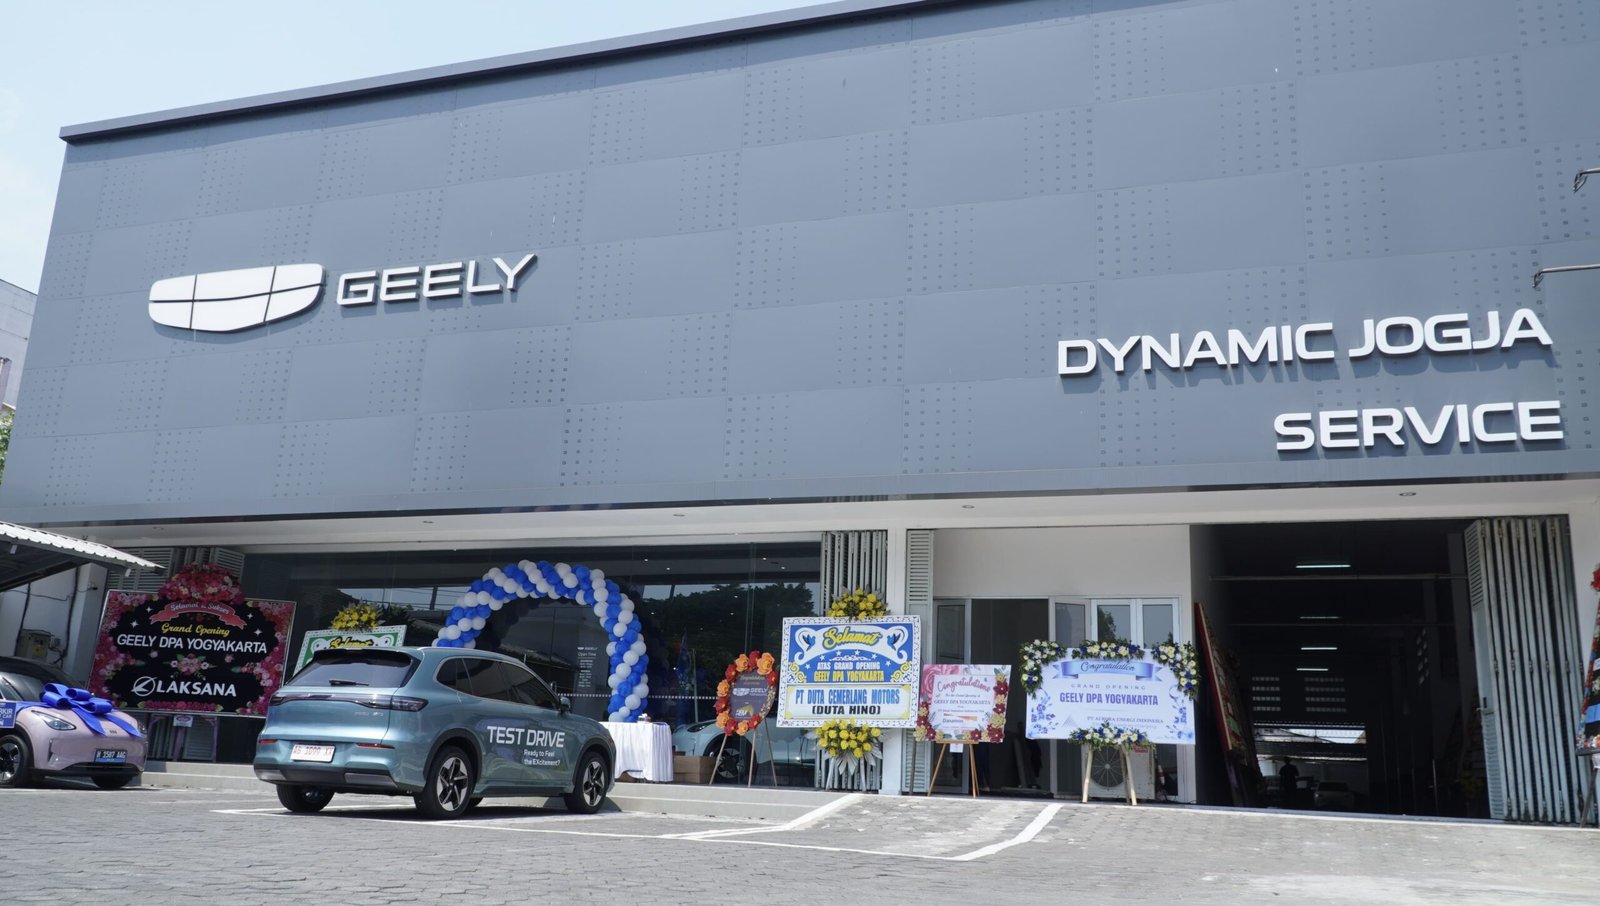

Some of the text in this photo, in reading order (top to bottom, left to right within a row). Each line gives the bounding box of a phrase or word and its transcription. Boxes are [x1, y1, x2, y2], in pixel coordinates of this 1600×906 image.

[336, 253, 536, 305] GEELY
[1058, 308, 1553, 376] DYNAMIC JOGJA
[1273, 400, 1564, 451] SERVICE
[161, 622, 230, 637] Grand Opening
[822, 625, 883, 650] Selamat
[117, 633, 267, 653] GEELY DPA YOGYAKARTA
[816, 661, 881, 670] ATAS GRAND OPENING
[813, 670, 884, 682] GEELY DPA YOGYAKARTA
[156, 680, 237, 697] LAKSANA
[795, 689, 900, 704] PT DUTA CEMERLANG MOTORS
[1059, 692, 1159, 705] GEELY DPA YOGYAKARTA
[487, 725, 565, 748] TEST DRIVE
[523, 749, 539, 758] Ready
